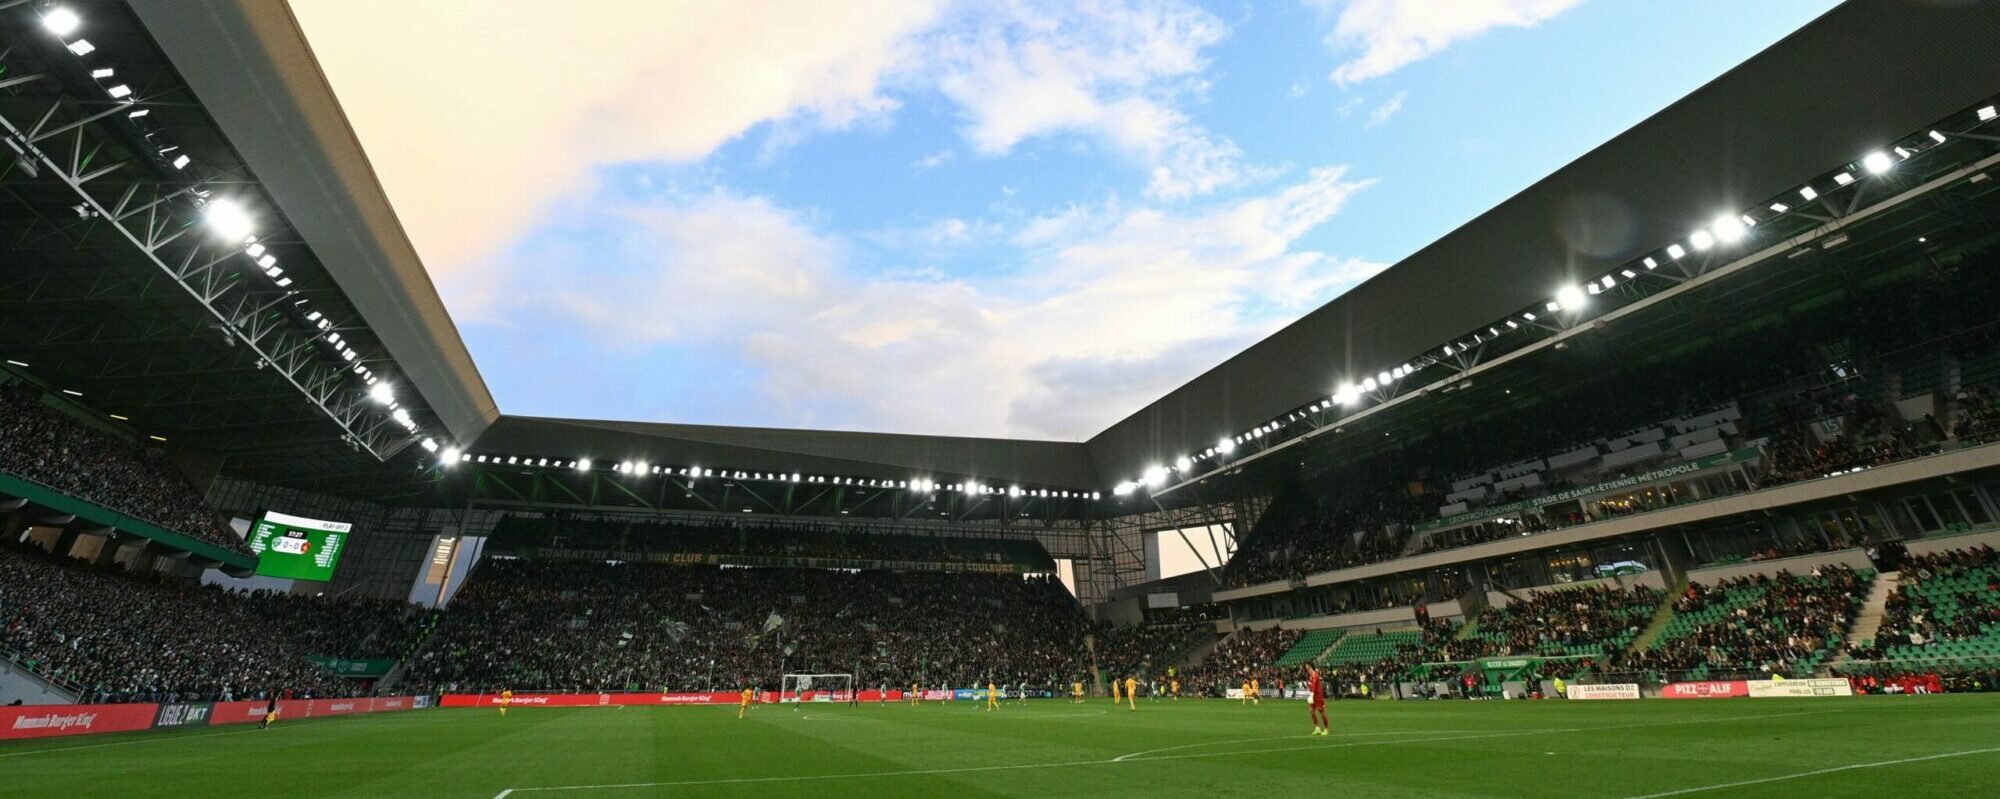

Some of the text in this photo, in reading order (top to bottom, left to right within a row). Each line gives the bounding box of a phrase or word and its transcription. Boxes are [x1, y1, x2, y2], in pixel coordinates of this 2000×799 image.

[1823, 418, 1840, 432] 15
[1532, 493, 1559, 506] STADE
[1559, 490, 1570, 500] DE
[1570, 477, 1638, 499] SAINT-ÉTIENNE
[1638, 462, 1700, 483] MÉTROPOLE
[647, 552, 670, 562] SON
[1596, 684, 1624, 692] MAISONS
[47, 714, 78, 730] Burger
[158, 705, 184, 726] LIGUE
[186, 707, 208, 721] BKT
